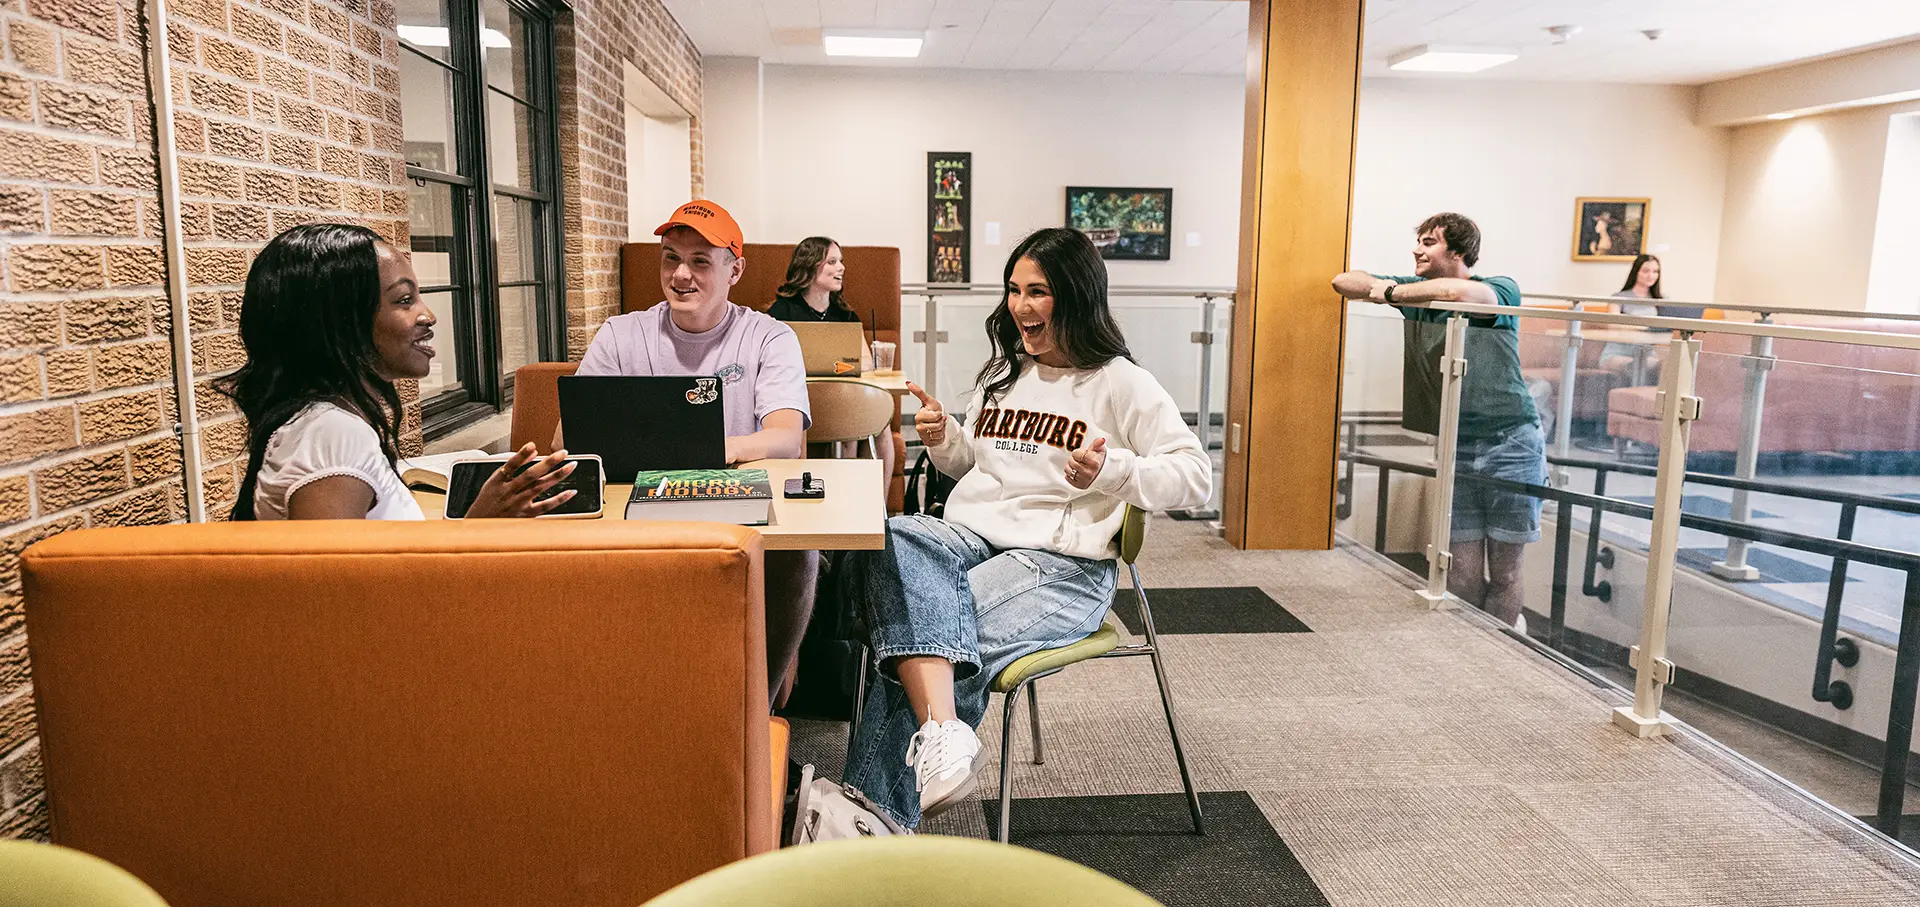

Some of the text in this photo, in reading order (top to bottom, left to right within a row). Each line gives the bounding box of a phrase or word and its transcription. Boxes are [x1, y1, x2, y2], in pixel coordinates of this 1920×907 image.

[995, 440, 1039, 454] COLLEGE
[666, 479, 740, 487] MICRO
[647, 485, 755, 497] BIOLOGY
